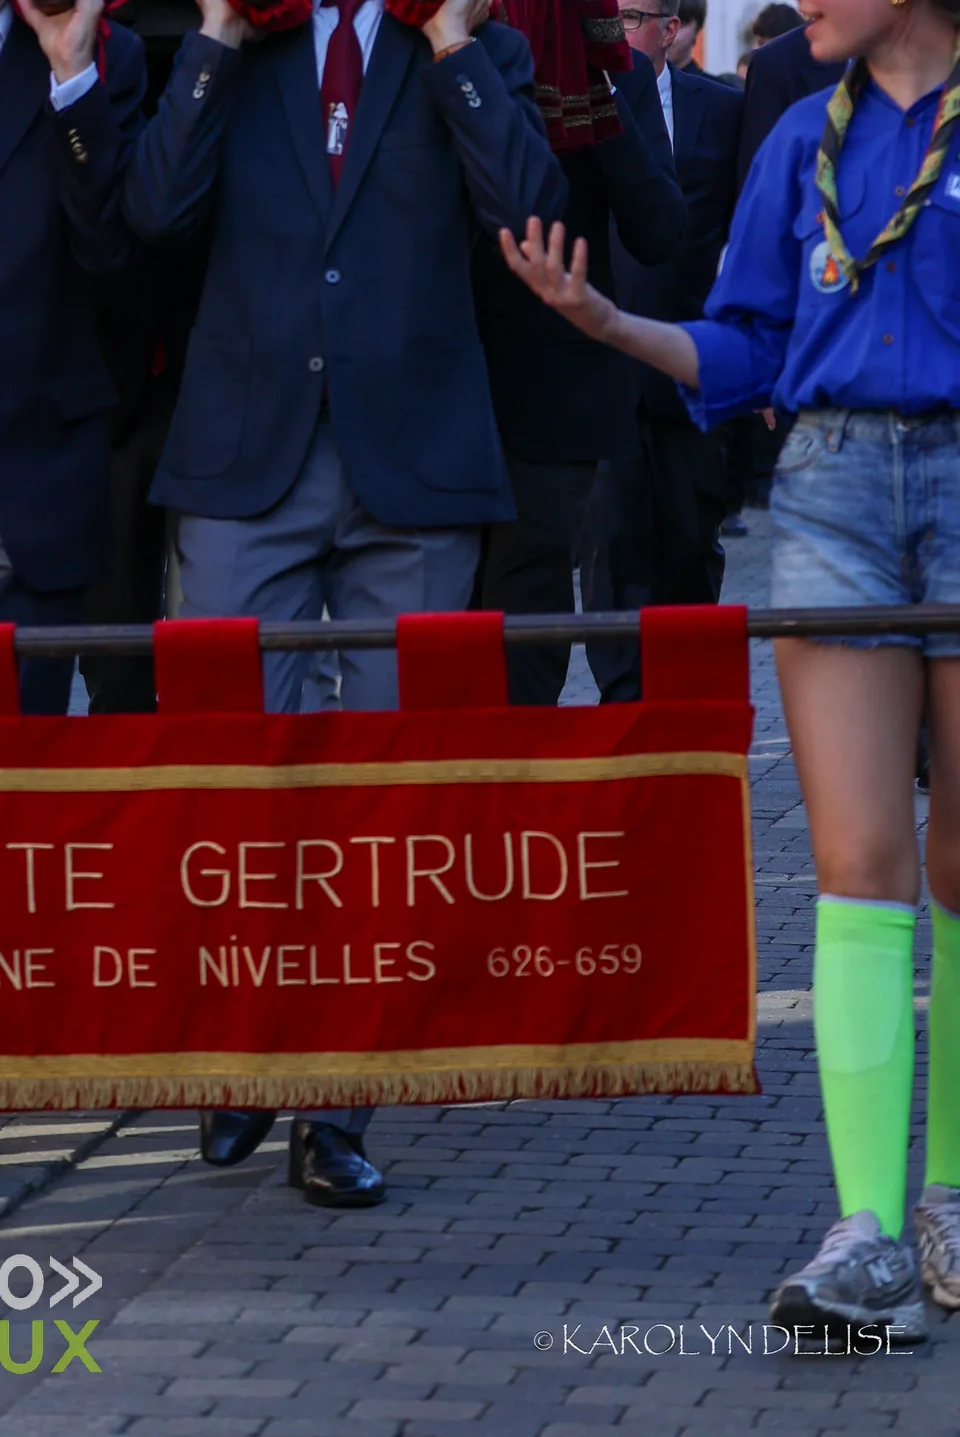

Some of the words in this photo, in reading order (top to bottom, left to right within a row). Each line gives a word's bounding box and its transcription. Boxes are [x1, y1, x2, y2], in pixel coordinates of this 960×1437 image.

[181, 831, 628, 909] GERTRUDE
[94, 946, 156, 988] DE
[489, 945, 642, 977] 626-659
